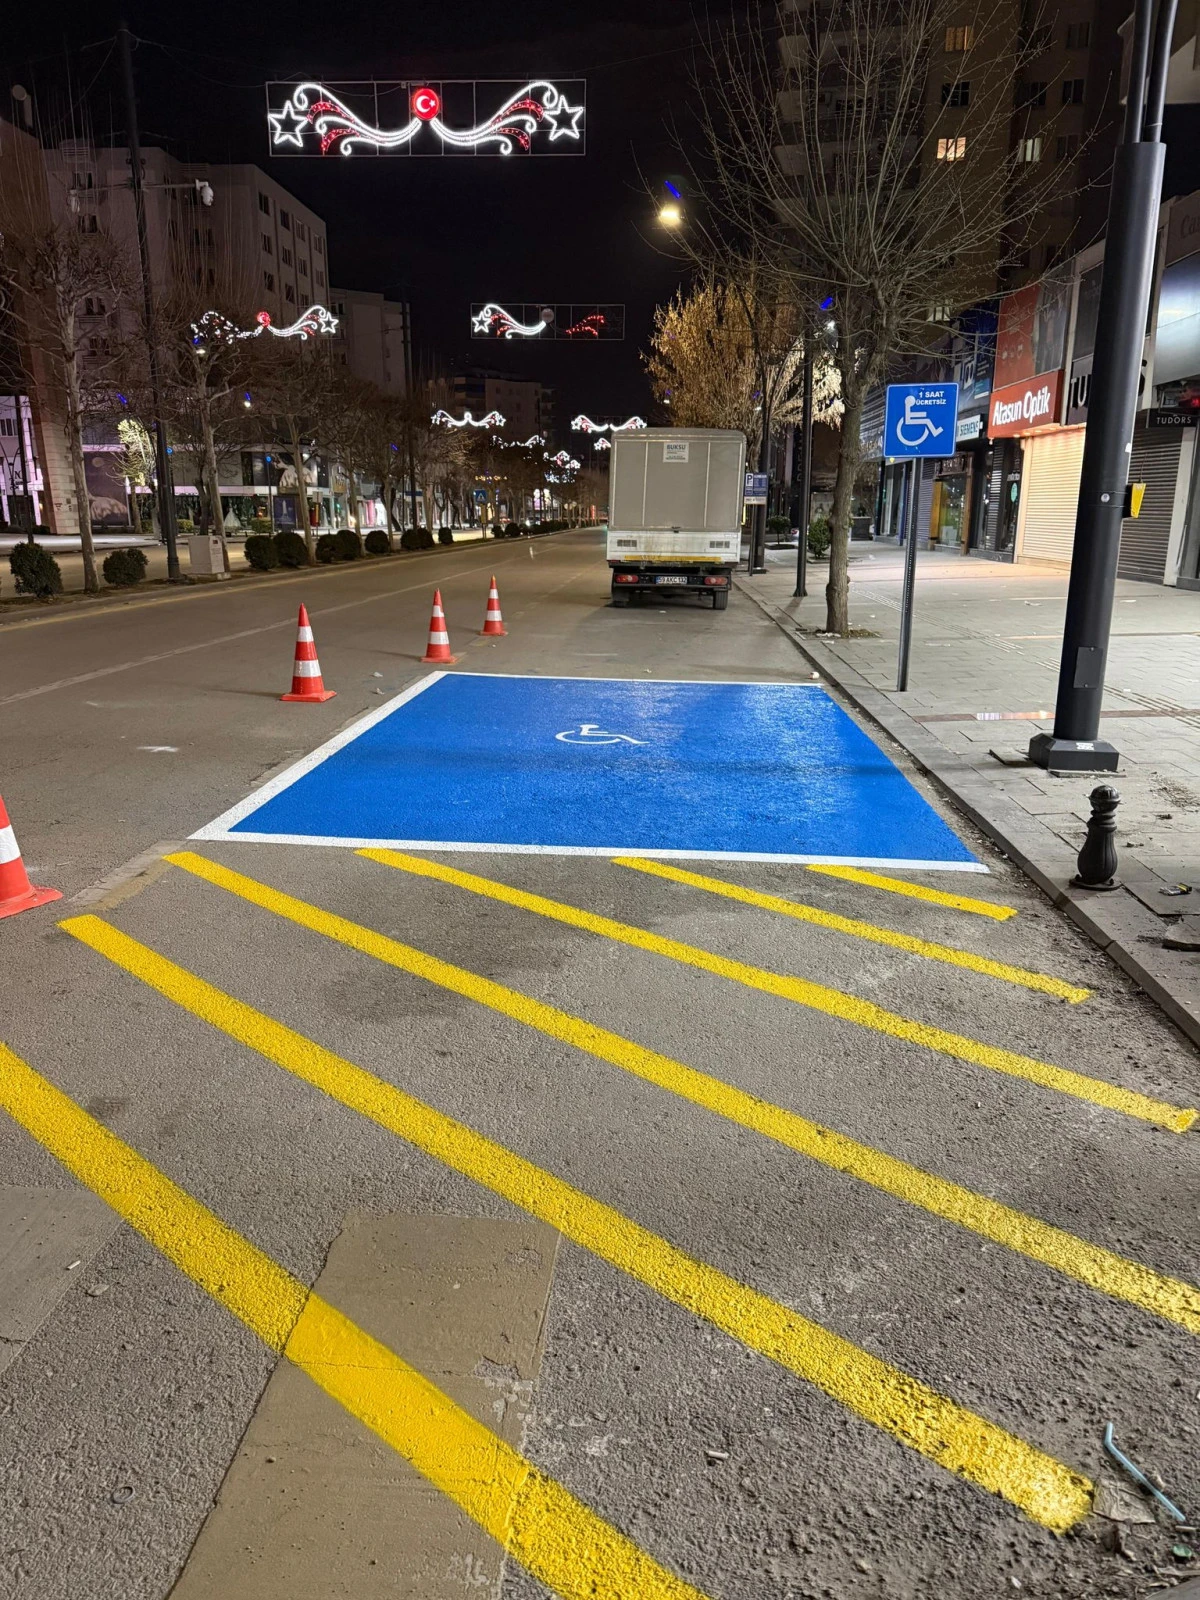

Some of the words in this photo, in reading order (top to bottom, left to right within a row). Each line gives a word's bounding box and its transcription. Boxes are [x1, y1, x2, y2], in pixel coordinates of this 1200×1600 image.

[992, 400, 1022, 427] Atasun
[1023, 385, 1051, 424] Optik
[1156, 416, 1192, 425] TUDORS
[746, 474, 753, 486] P
